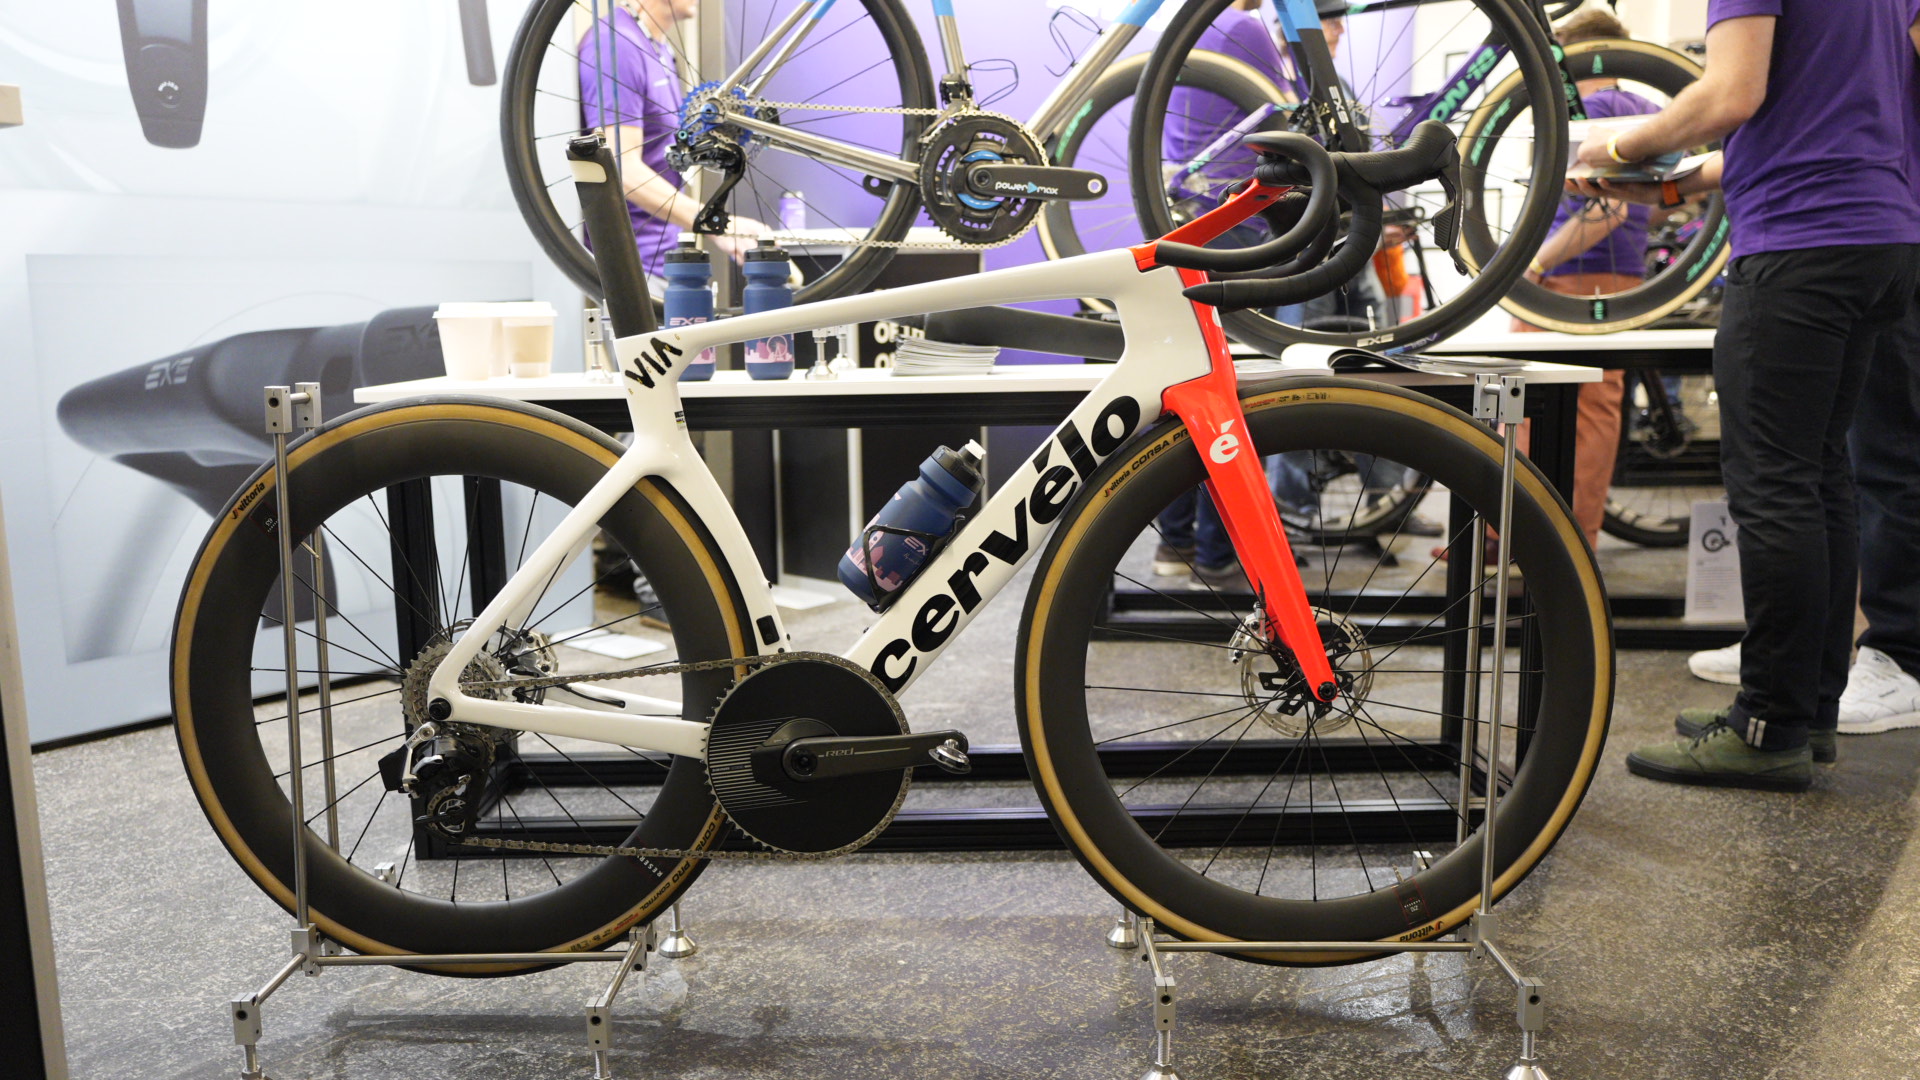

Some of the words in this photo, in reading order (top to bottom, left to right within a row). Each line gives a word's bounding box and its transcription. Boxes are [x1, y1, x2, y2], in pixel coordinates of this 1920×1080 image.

[146, 357, 193, 389] EXS
[624, 337, 683, 389] VIA
[1209, 419, 1240, 464] é
[1110, 470, 1131, 490] vittoria
[1131, 439, 1170, 471] CORSA
[1173, 428, 1188, 441] PR
[238, 482, 266, 512] vittoria
[871, 395, 1141, 694] cervélo
[695, 822, 717, 852] CORS
[636, 855, 664, 878] RESER
[672, 860, 692, 883] PRO
[640, 881, 671, 911] CONTROL
[1400, 925, 1435, 942] vittoria
